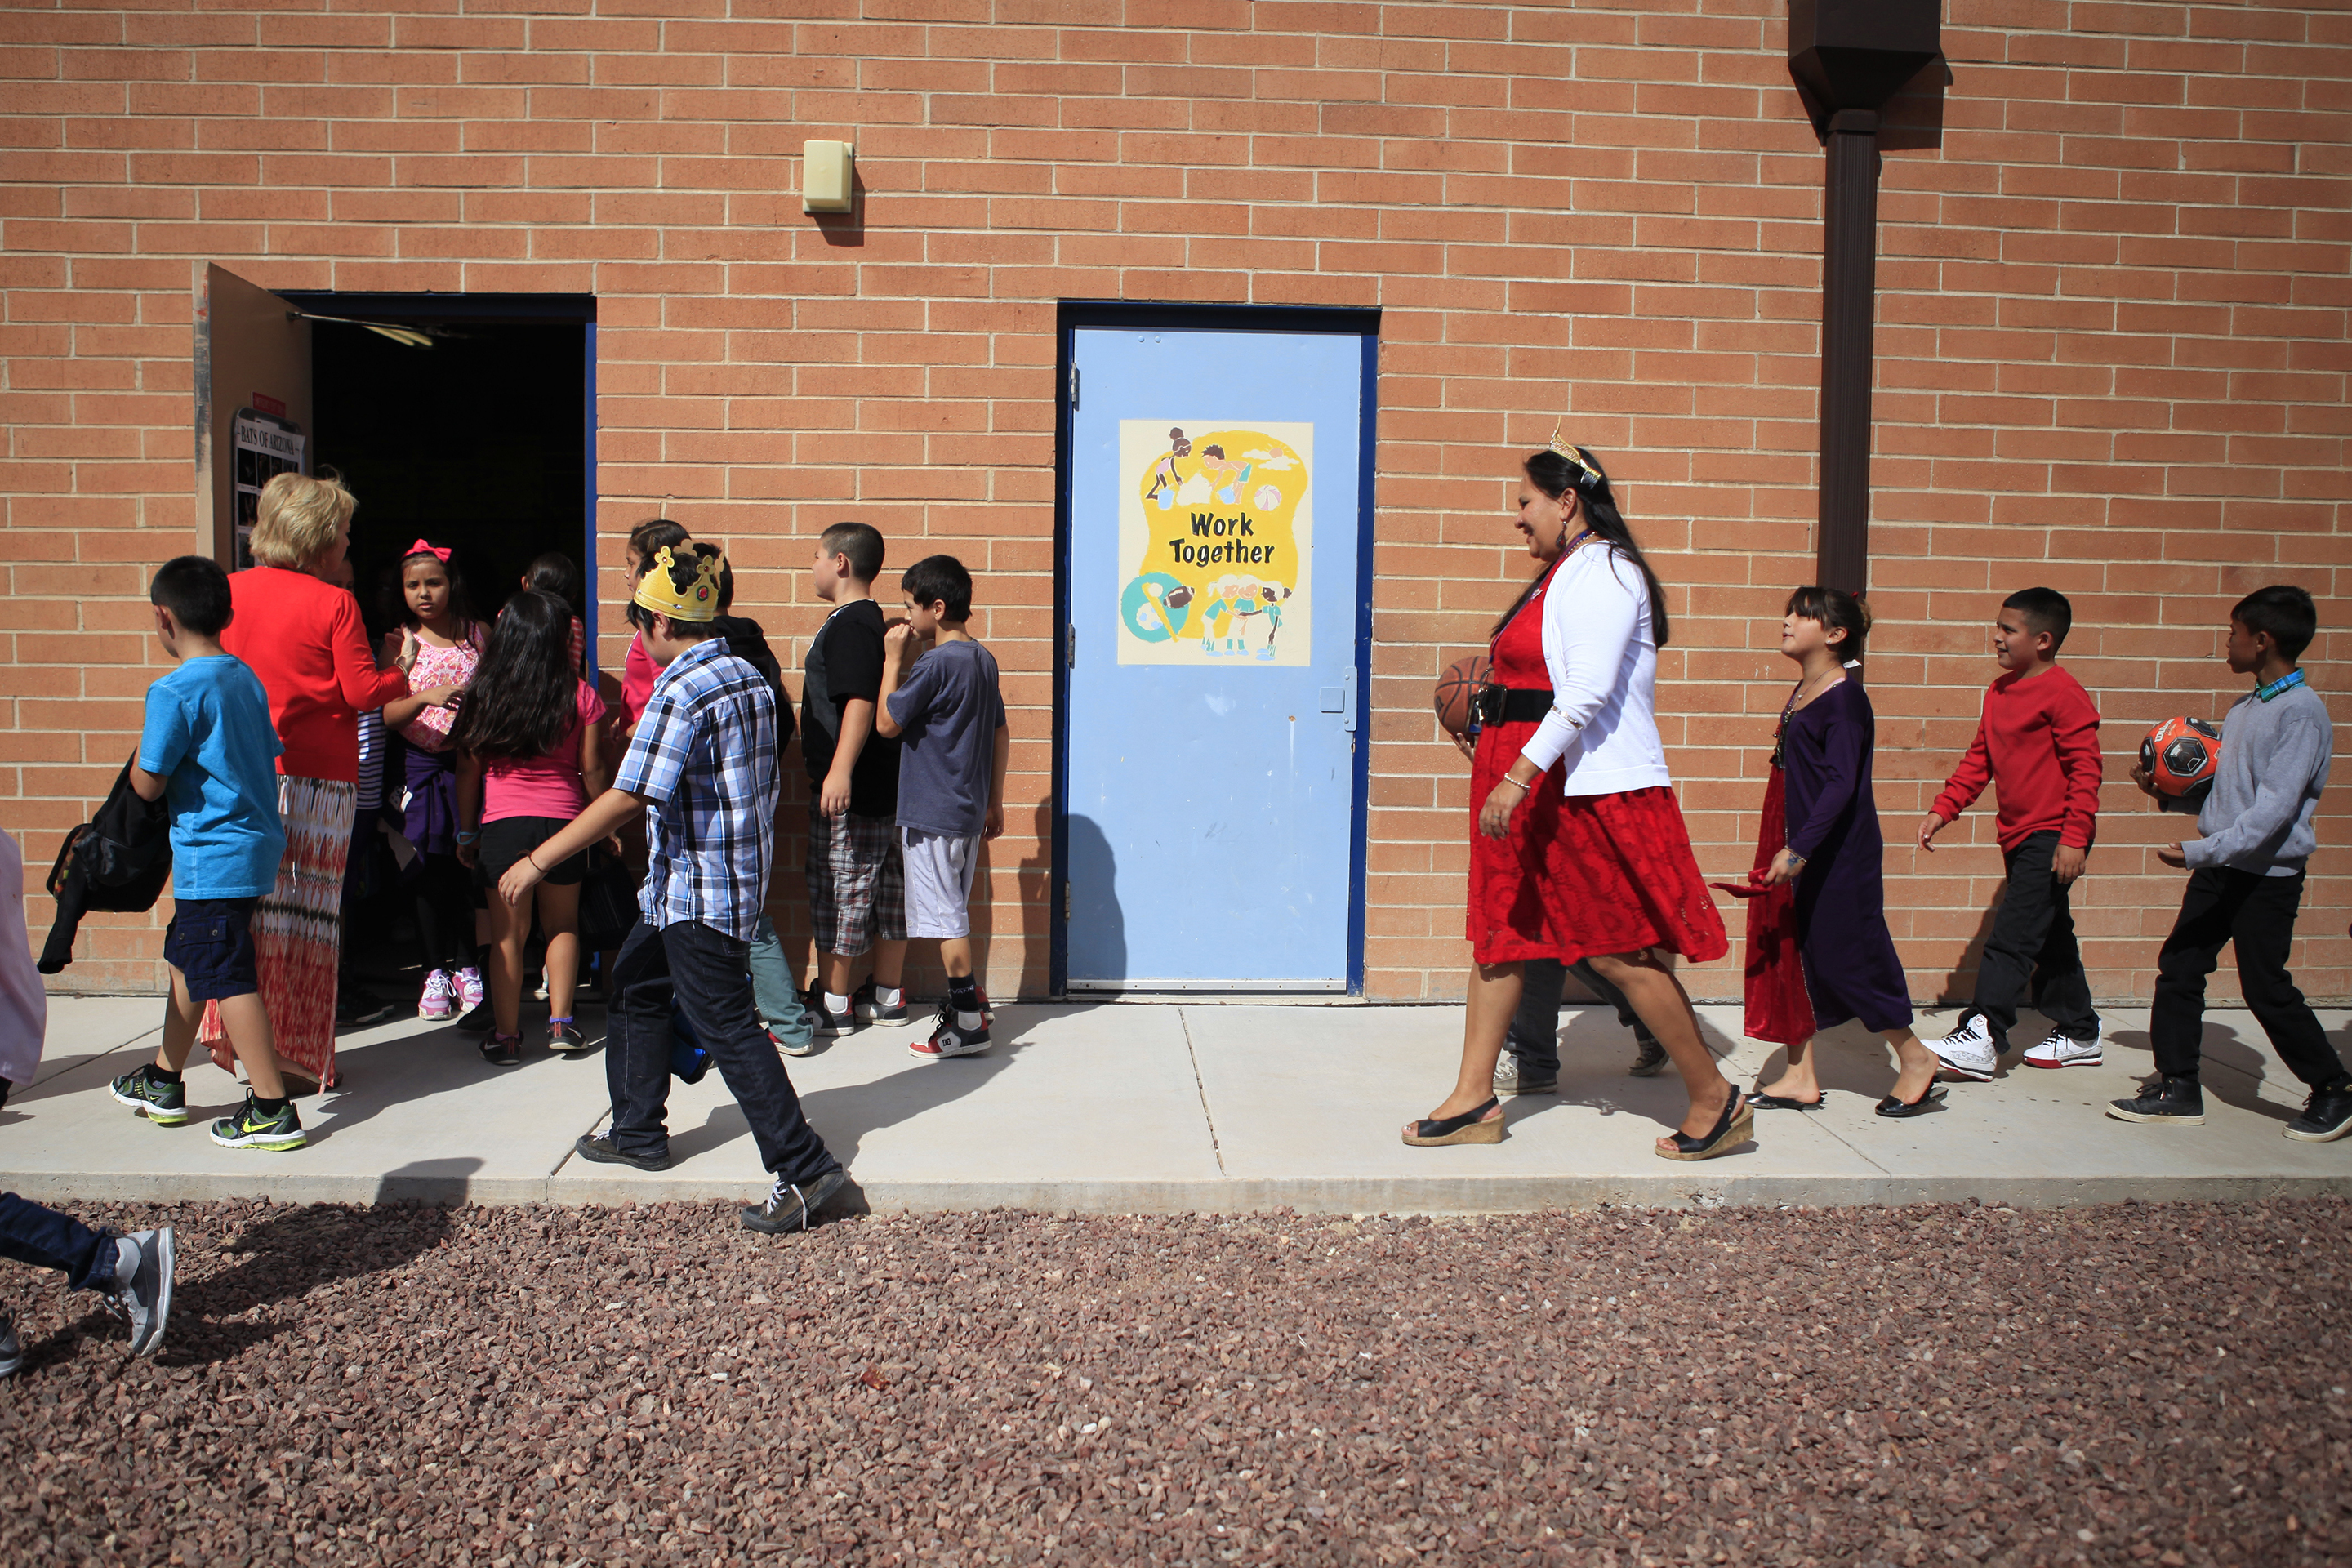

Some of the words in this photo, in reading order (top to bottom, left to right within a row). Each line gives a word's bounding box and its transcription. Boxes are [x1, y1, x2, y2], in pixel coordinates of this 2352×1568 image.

[241, 425, 257, 445] BATS
[259, 430, 268, 448] OF
[270, 434, 294, 455] ARIZONA
[1190, 511, 1254, 537] Work
[1169, 538, 1275, 568] Together
